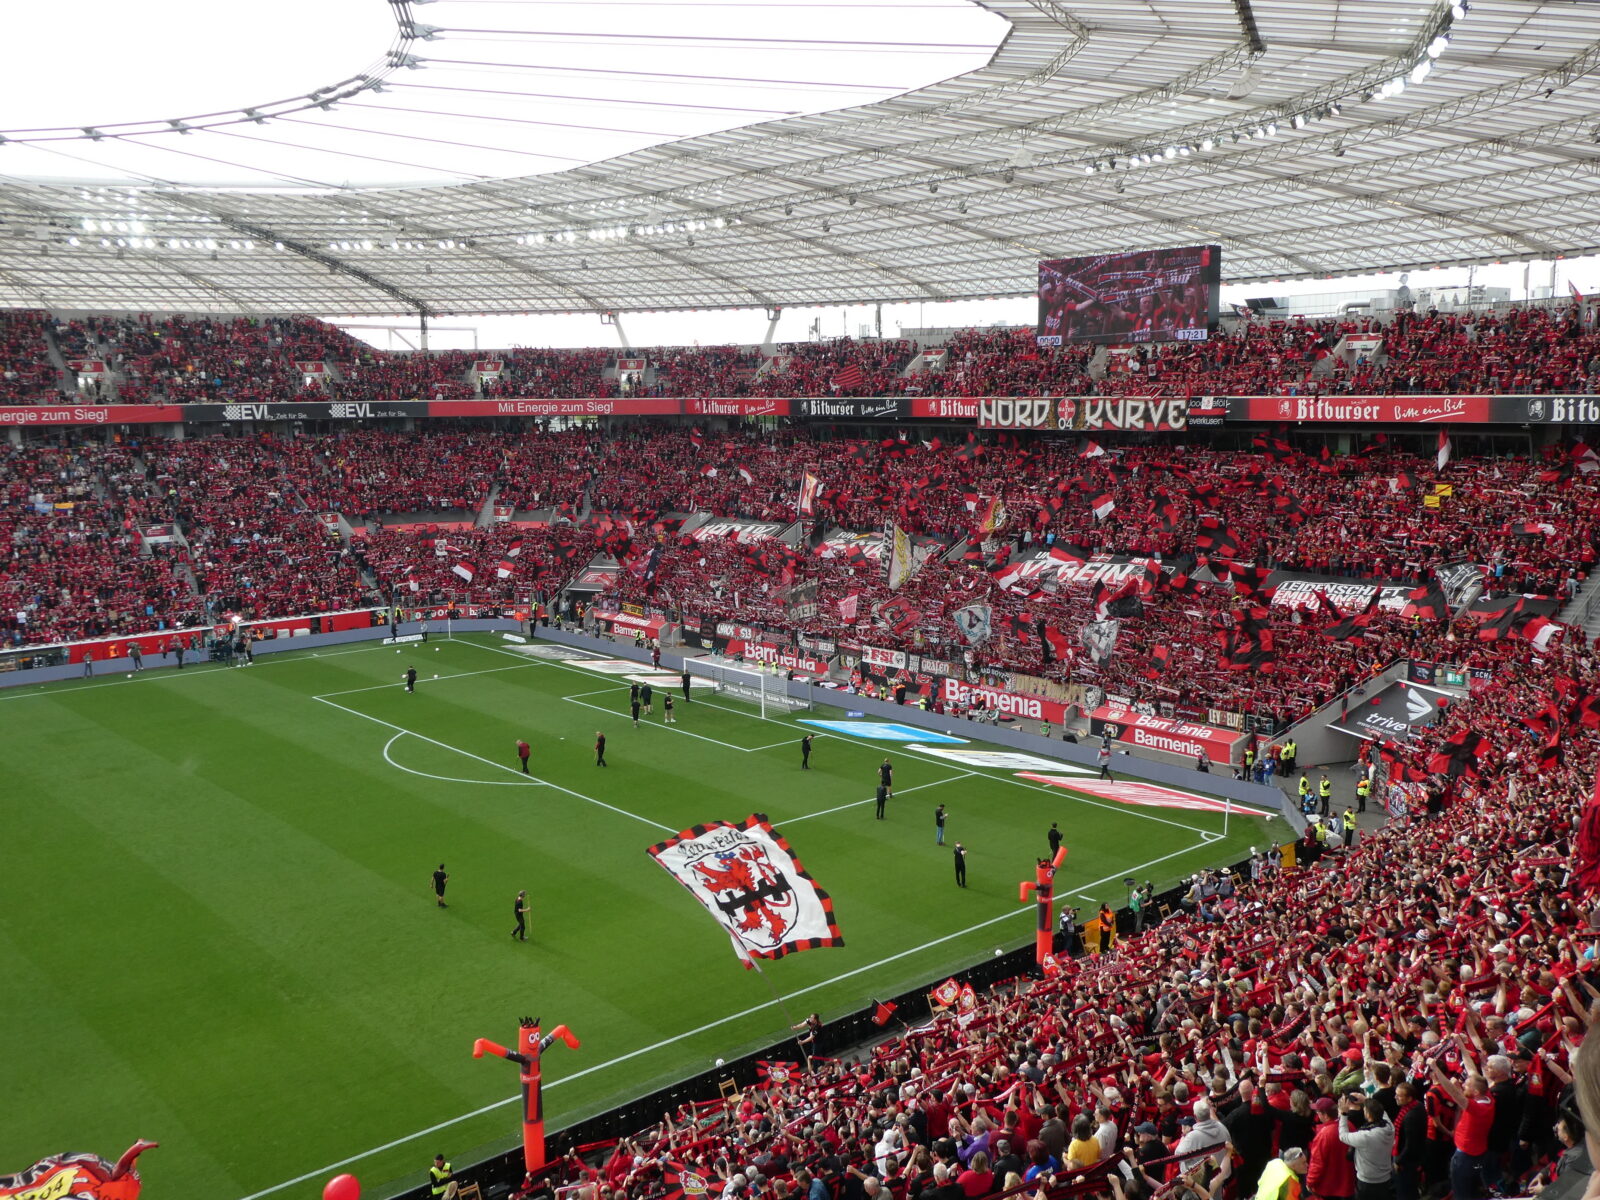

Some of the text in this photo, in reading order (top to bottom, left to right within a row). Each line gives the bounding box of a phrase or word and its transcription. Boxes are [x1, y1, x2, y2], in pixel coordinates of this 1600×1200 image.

[1182, 330, 1204, 340] 17:21
[345, 403, 375, 418] EVL
[498, 402, 614, 415] Mit Energie zum Sieg!
[810, 399, 855, 415] Bitburger
[979, 398, 1187, 429] NORD KURVE
[1296, 398, 1466, 420] Bitburger Bitte ein Bit
[0, 408, 108, 424] ergie zum Sieg!
[1058, 417, 1073, 430] 04
[1366, 712, 1407, 732] trive
[1134, 728, 1202, 756] Barmenia
